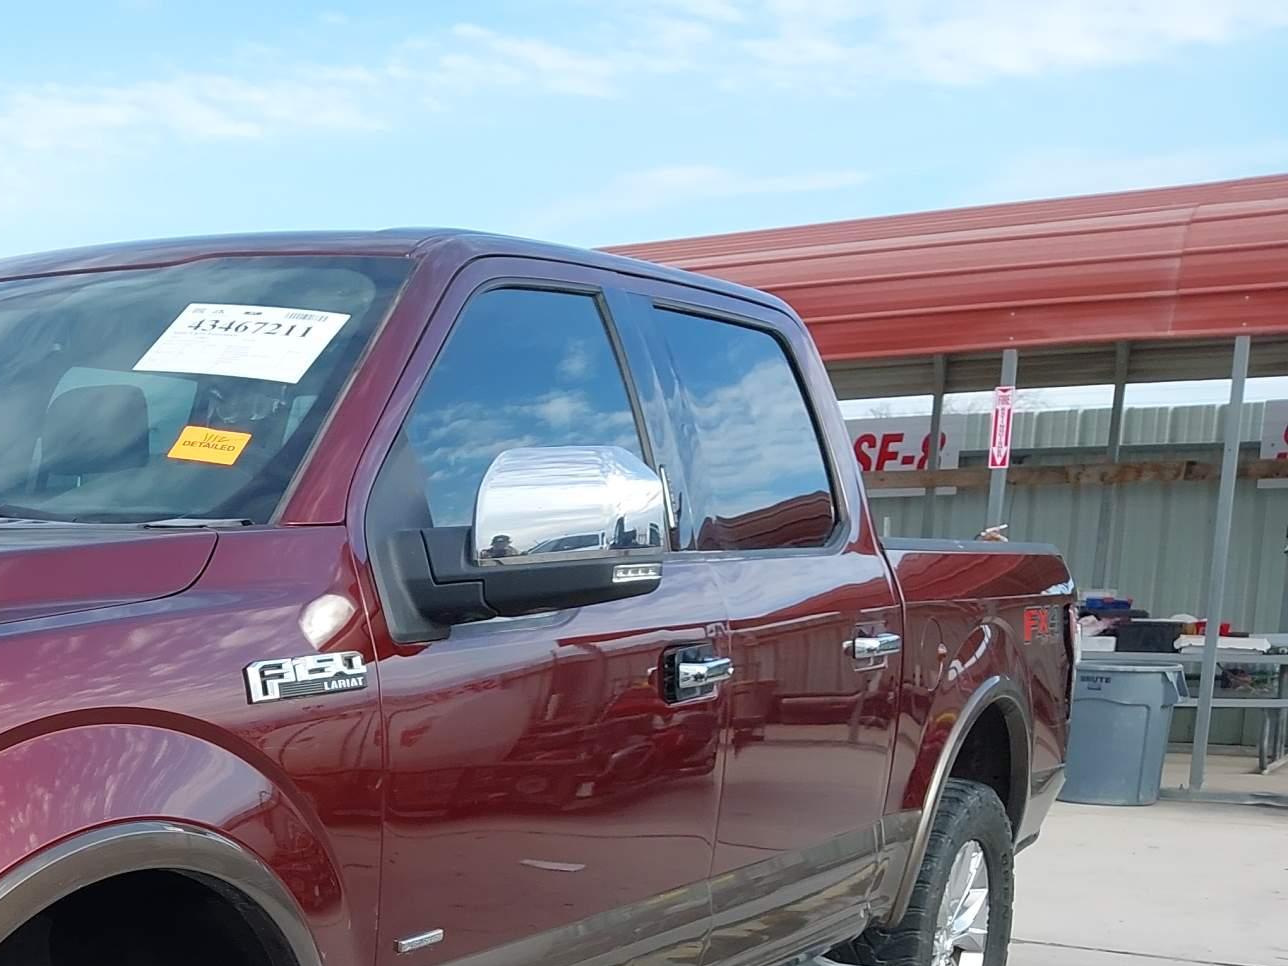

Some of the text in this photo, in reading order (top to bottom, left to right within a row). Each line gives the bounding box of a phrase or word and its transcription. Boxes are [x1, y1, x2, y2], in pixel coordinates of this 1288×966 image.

[188, 319, 314, 338] 43467211
[182, 440, 236, 452] DETAILED
[323, 677, 365, 691] LARIAT
